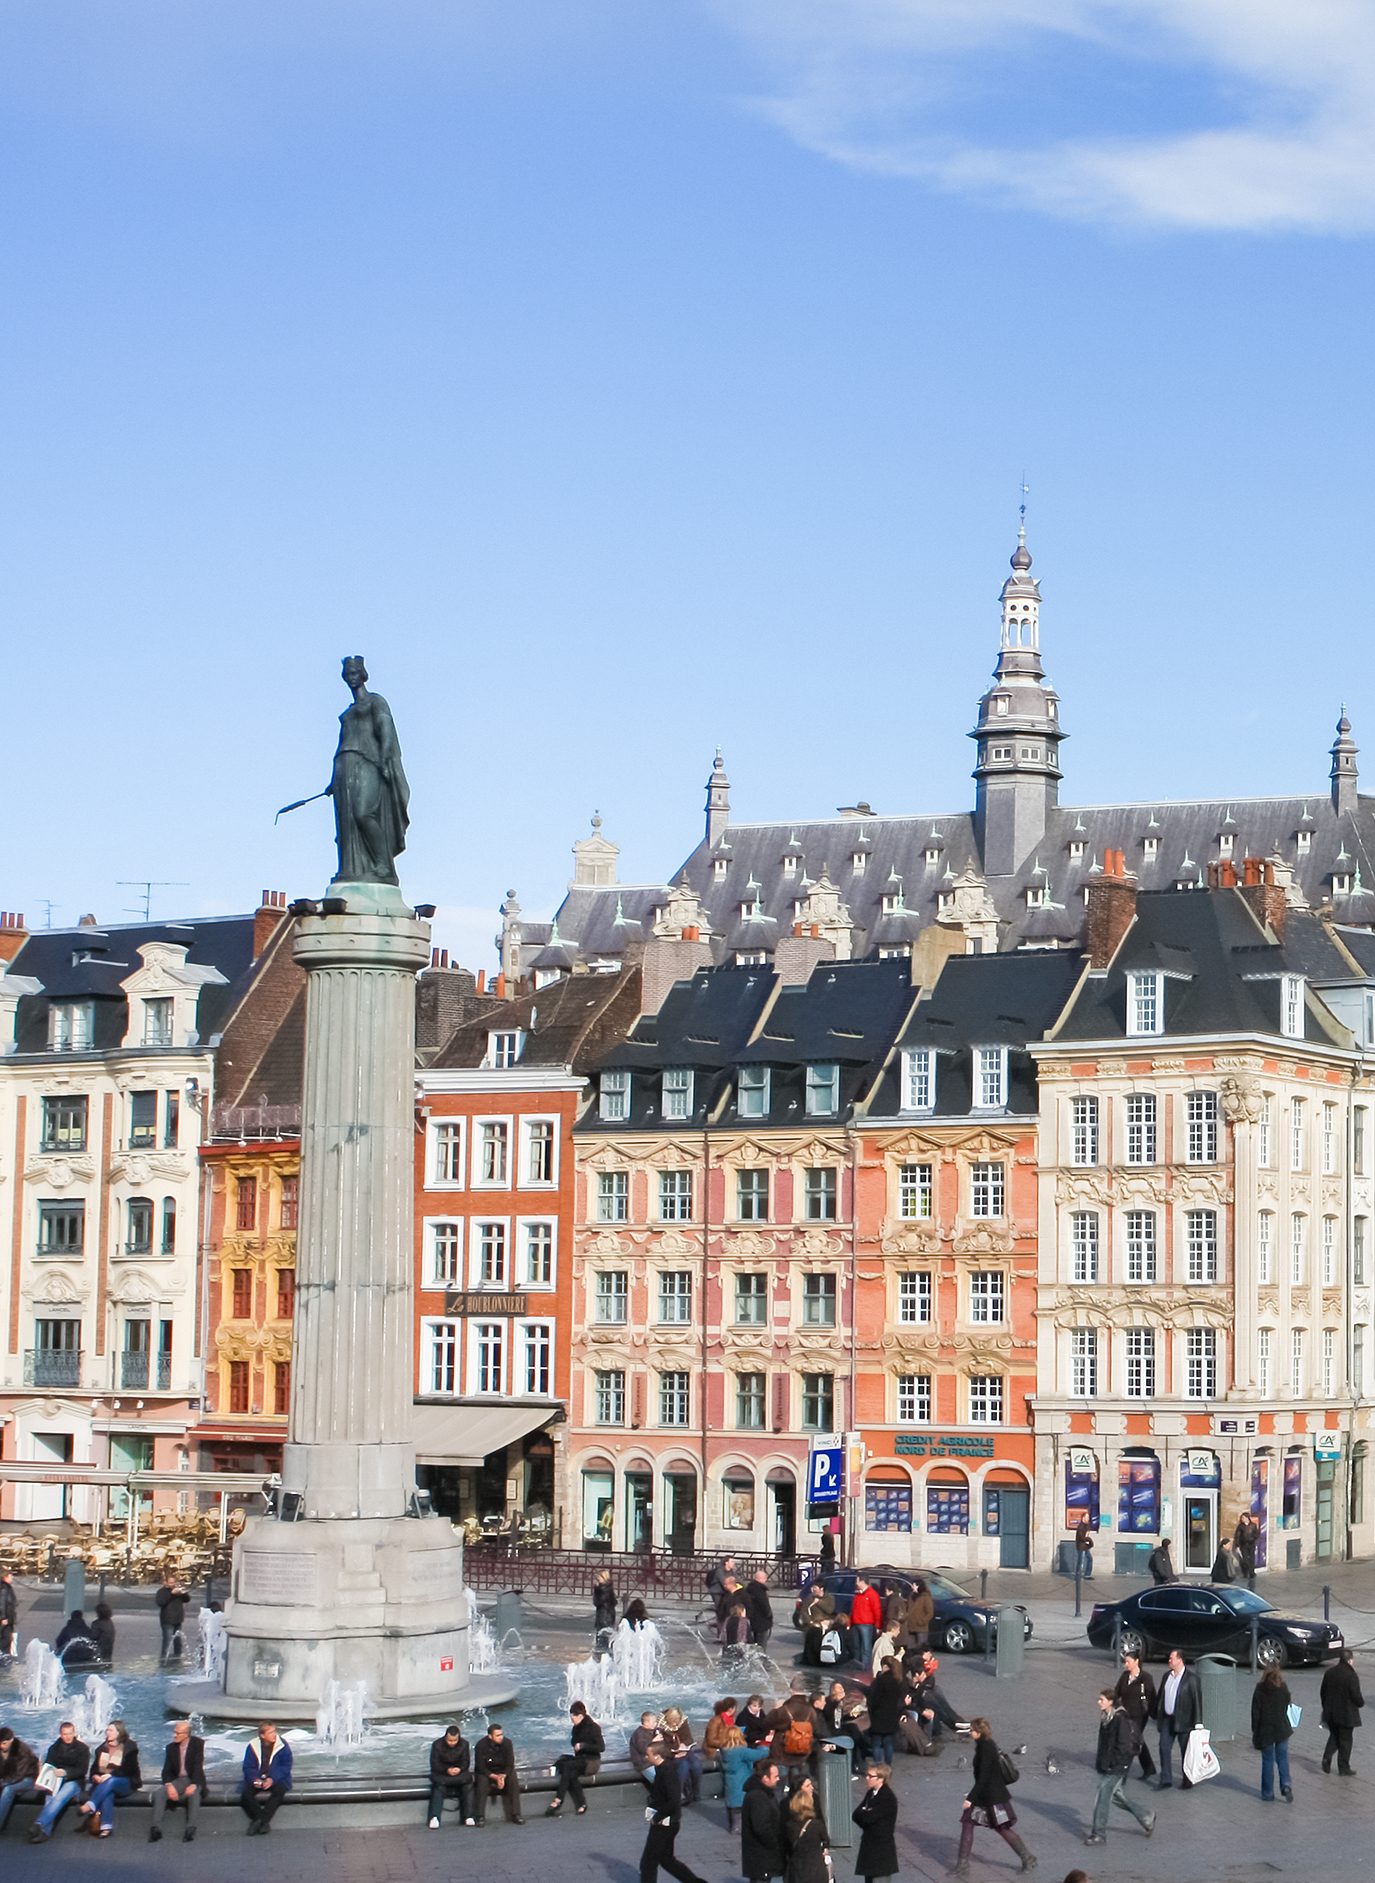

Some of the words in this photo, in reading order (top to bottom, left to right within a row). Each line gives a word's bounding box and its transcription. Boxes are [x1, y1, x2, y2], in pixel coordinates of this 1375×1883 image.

[938, 1437, 994, 1446] AGRICOLE
[895, 1446, 926, 1455] NORD
[930, 1447, 945, 1456] DE
[949, 1448, 994, 1457] FRANCE
[814, 1454, 830, 1488] P
